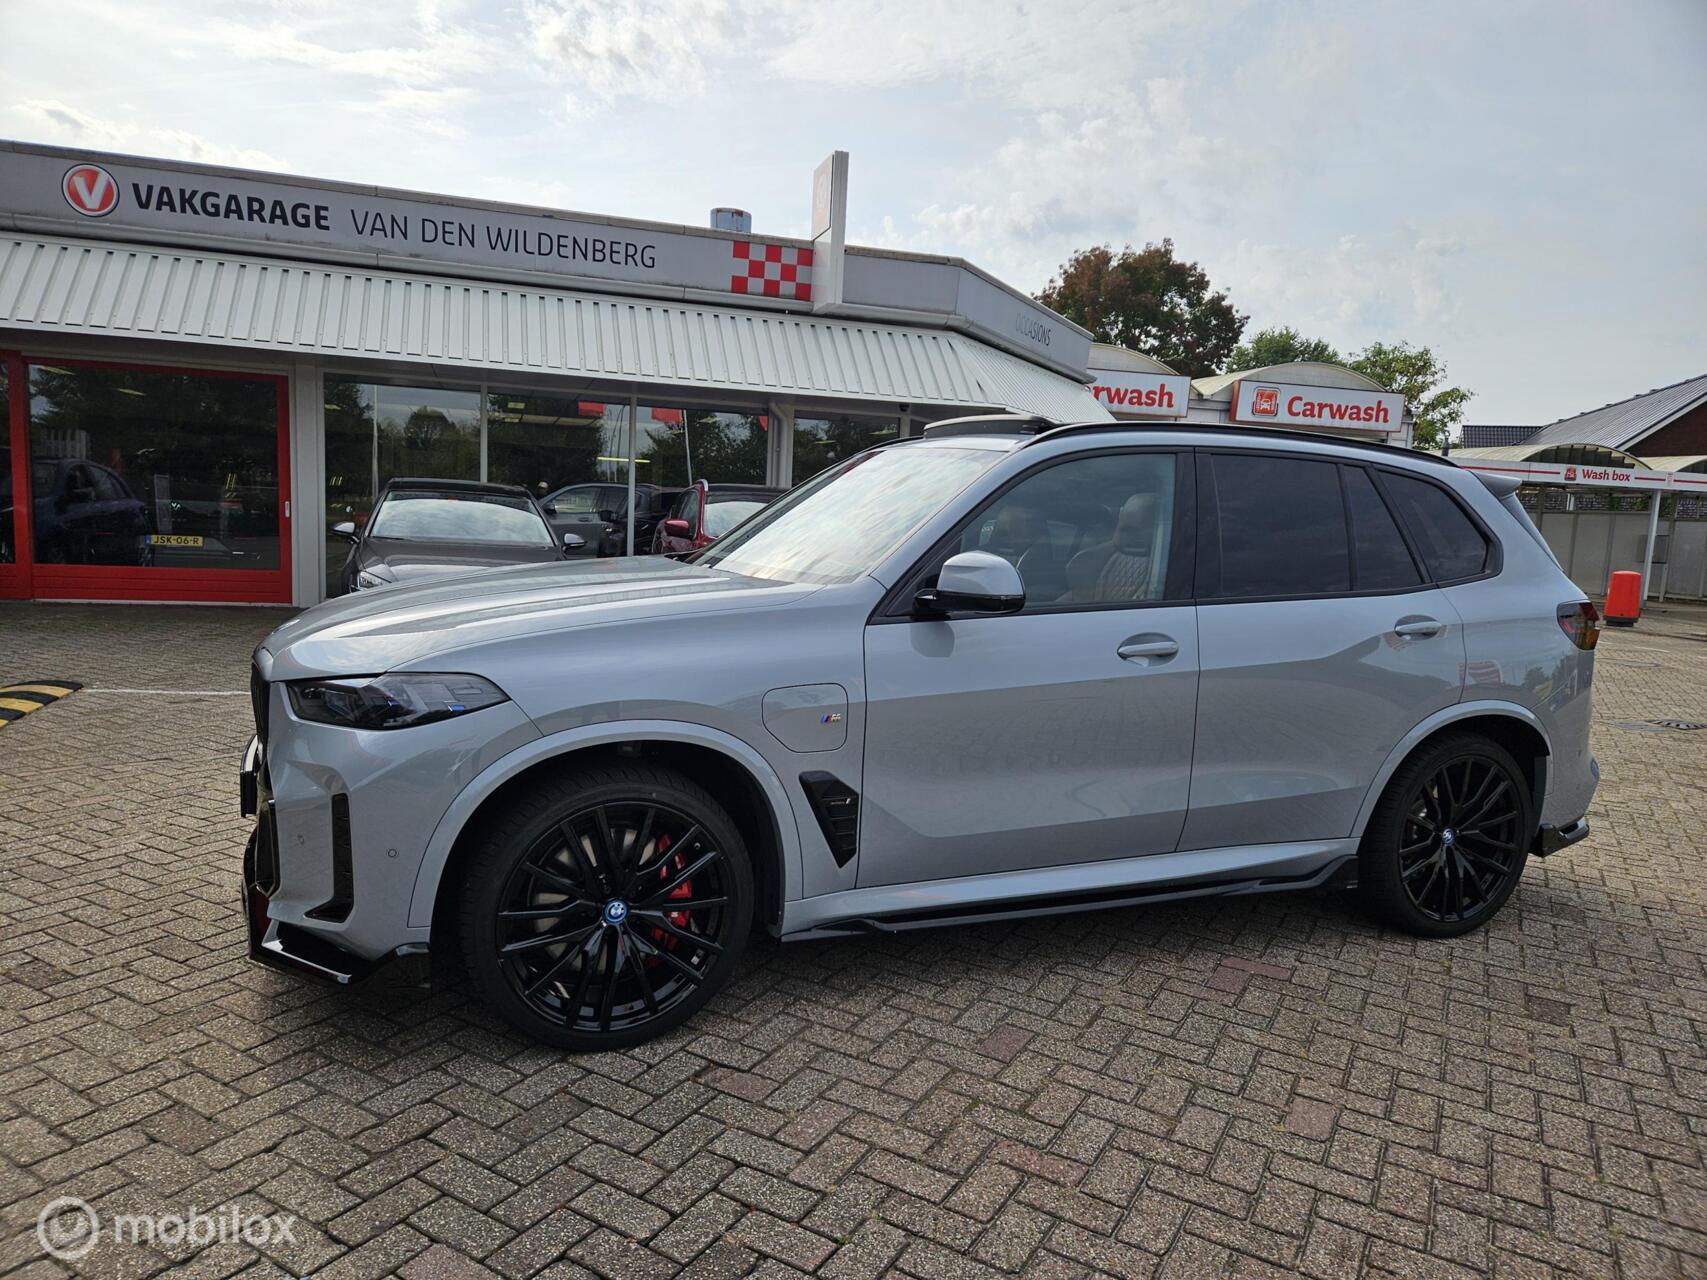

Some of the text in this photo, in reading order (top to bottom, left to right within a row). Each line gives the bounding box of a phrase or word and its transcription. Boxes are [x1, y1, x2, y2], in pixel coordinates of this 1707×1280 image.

[131, 182, 331, 231] VAKGARAGE
[350, 209, 409, 241] VAN
[421, 218, 476, 249] DEN
[486, 225, 657, 269] WILDENBERG
[1015, 312, 1052, 347] OCCASIONS
[1086, 383, 1175, 408] rwash
[1287, 395, 1390, 424] Carwash
[1581, 468, 1632, 482] Wash box
[153, 535, 200, 546] JSK-06-R
